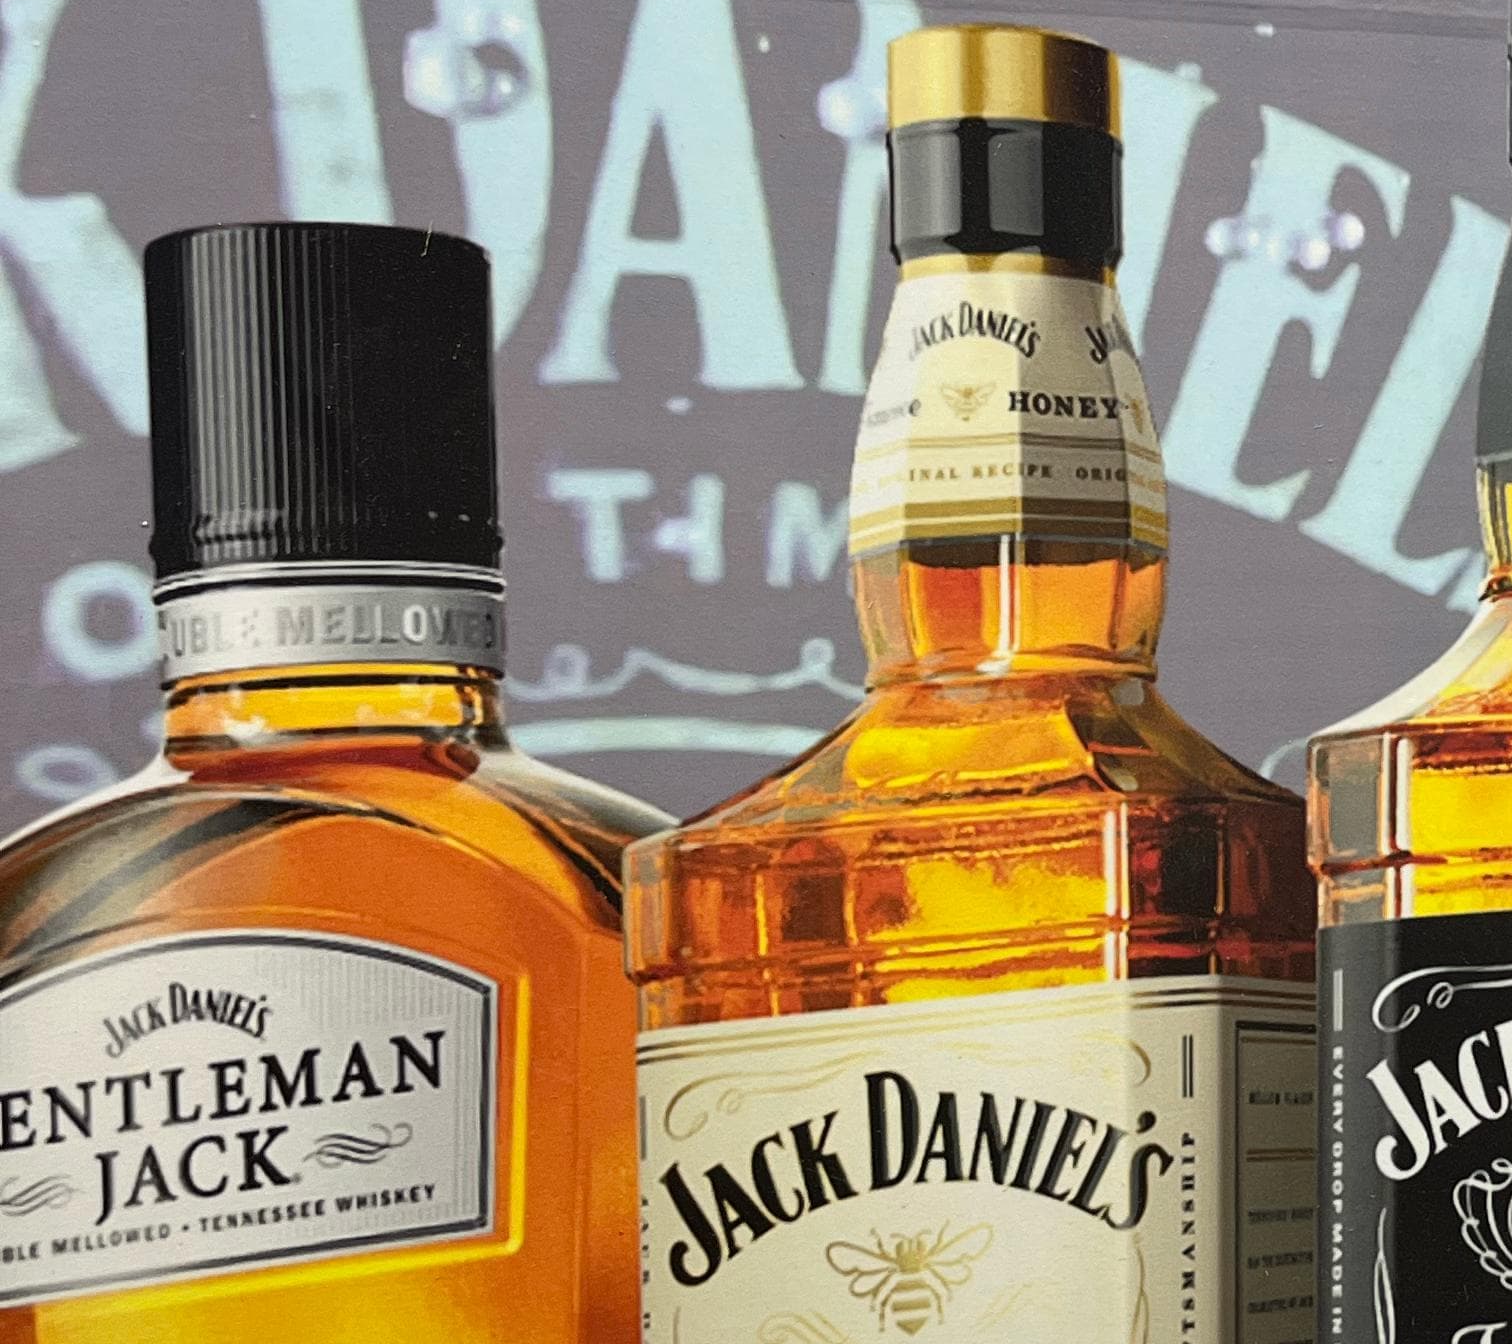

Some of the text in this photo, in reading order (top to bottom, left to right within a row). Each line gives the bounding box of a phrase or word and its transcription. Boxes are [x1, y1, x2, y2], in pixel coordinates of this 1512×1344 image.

[910, 309, 955, 360] JACK
[958, 300, 1041, 359] DANIEL'S
[1008, 390, 1120, 419] HONEY
[102, 980, 272, 1059] JACK DANIEL'S
[0, 1029, 446, 1152] ENTLEMAN
[1331, 1045, 1344, 1133] EVERY
[95, 1125, 292, 1227] JACK
[658, 1069, 1176, 1288] JACK DANIEL'S
[1331, 1140, 1344, 1214] DROP
[52, 1184, 437, 1258] MELLOWED TENNESSEE WHISKEY
[1331, 1222, 1344, 1298] MADE
[1331, 1306, 1344, 1335] IN
